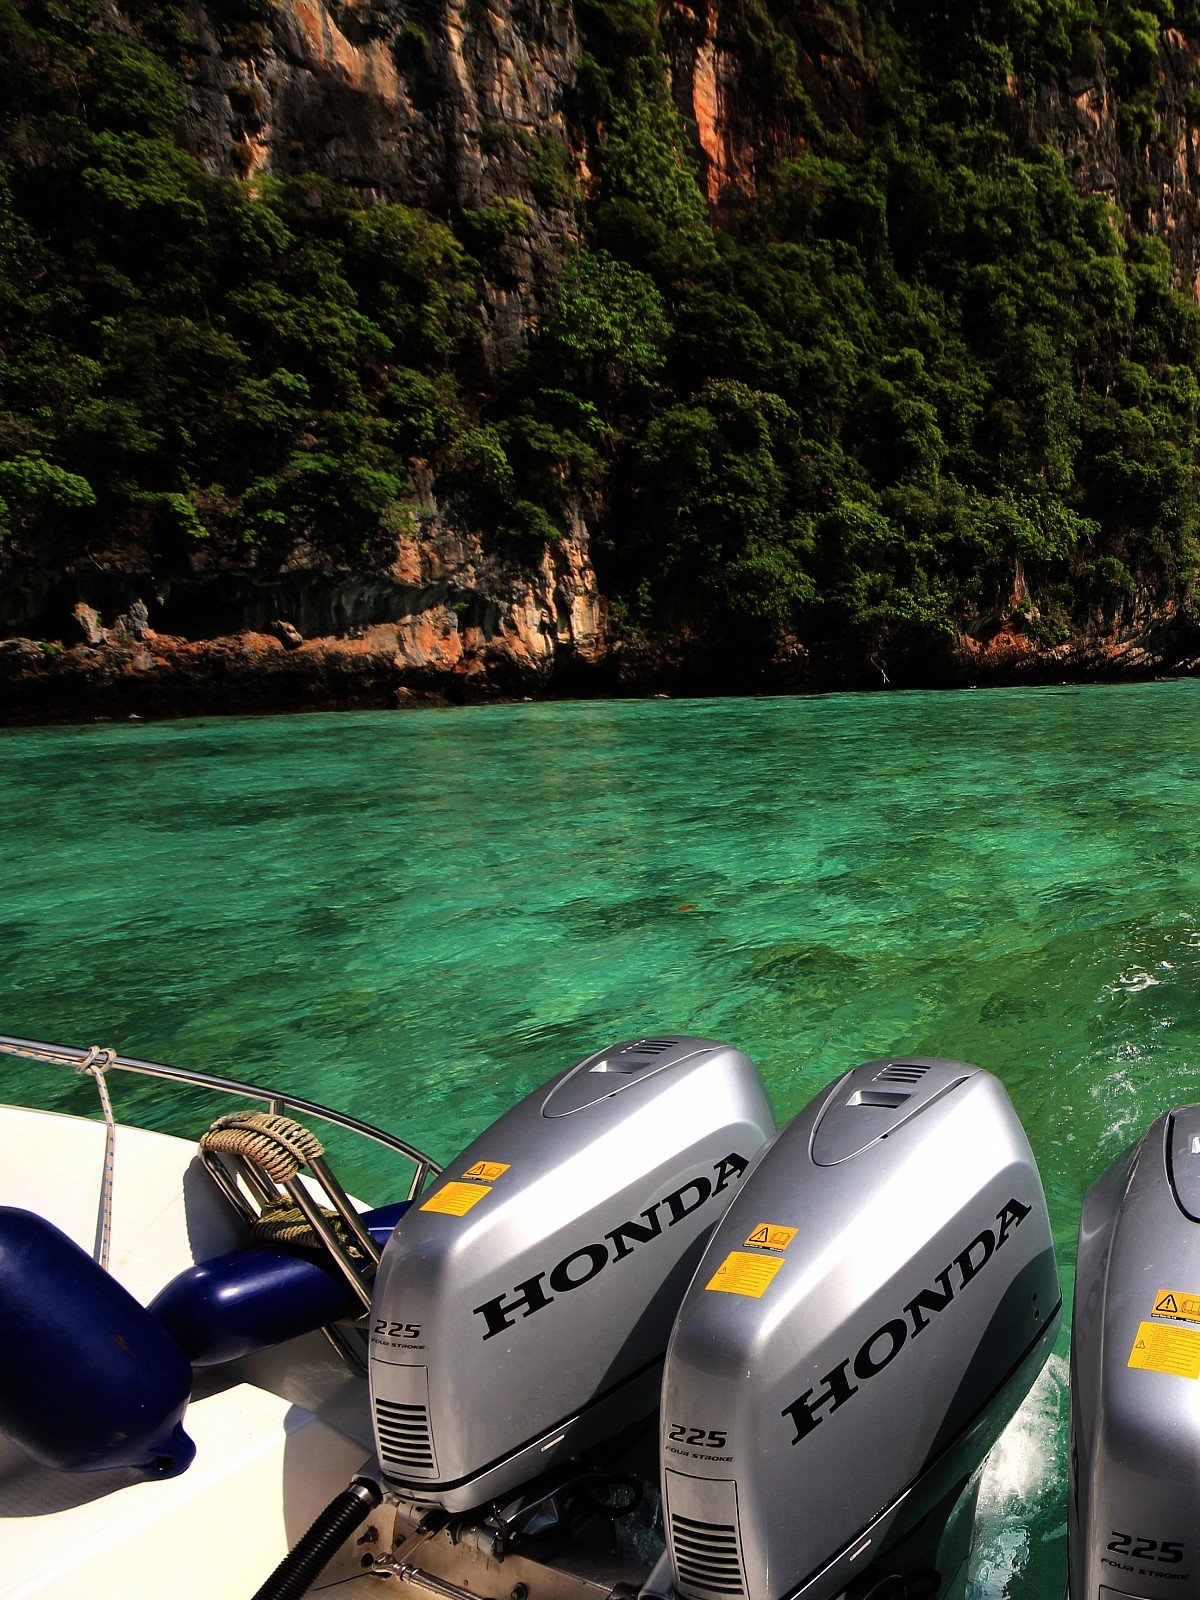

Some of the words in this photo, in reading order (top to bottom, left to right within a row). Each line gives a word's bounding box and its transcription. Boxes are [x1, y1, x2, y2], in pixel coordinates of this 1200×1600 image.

[473, 1152, 750, 1341] HONDA
[374, 1319, 421, 1338] 225
[780, 1198, 1032, 1446] HONDA
[371, 1338, 389, 1346] FOUR
[669, 1423, 728, 1448] 225
[665, 1446, 690, 1457] FOUR
[691, 1453, 734, 1462] STROKE
[1107, 1531, 1185, 1563] 225
[1101, 1558, 1135, 1572] FOUR
[1137, 1568, 1191, 1580] STROKE
